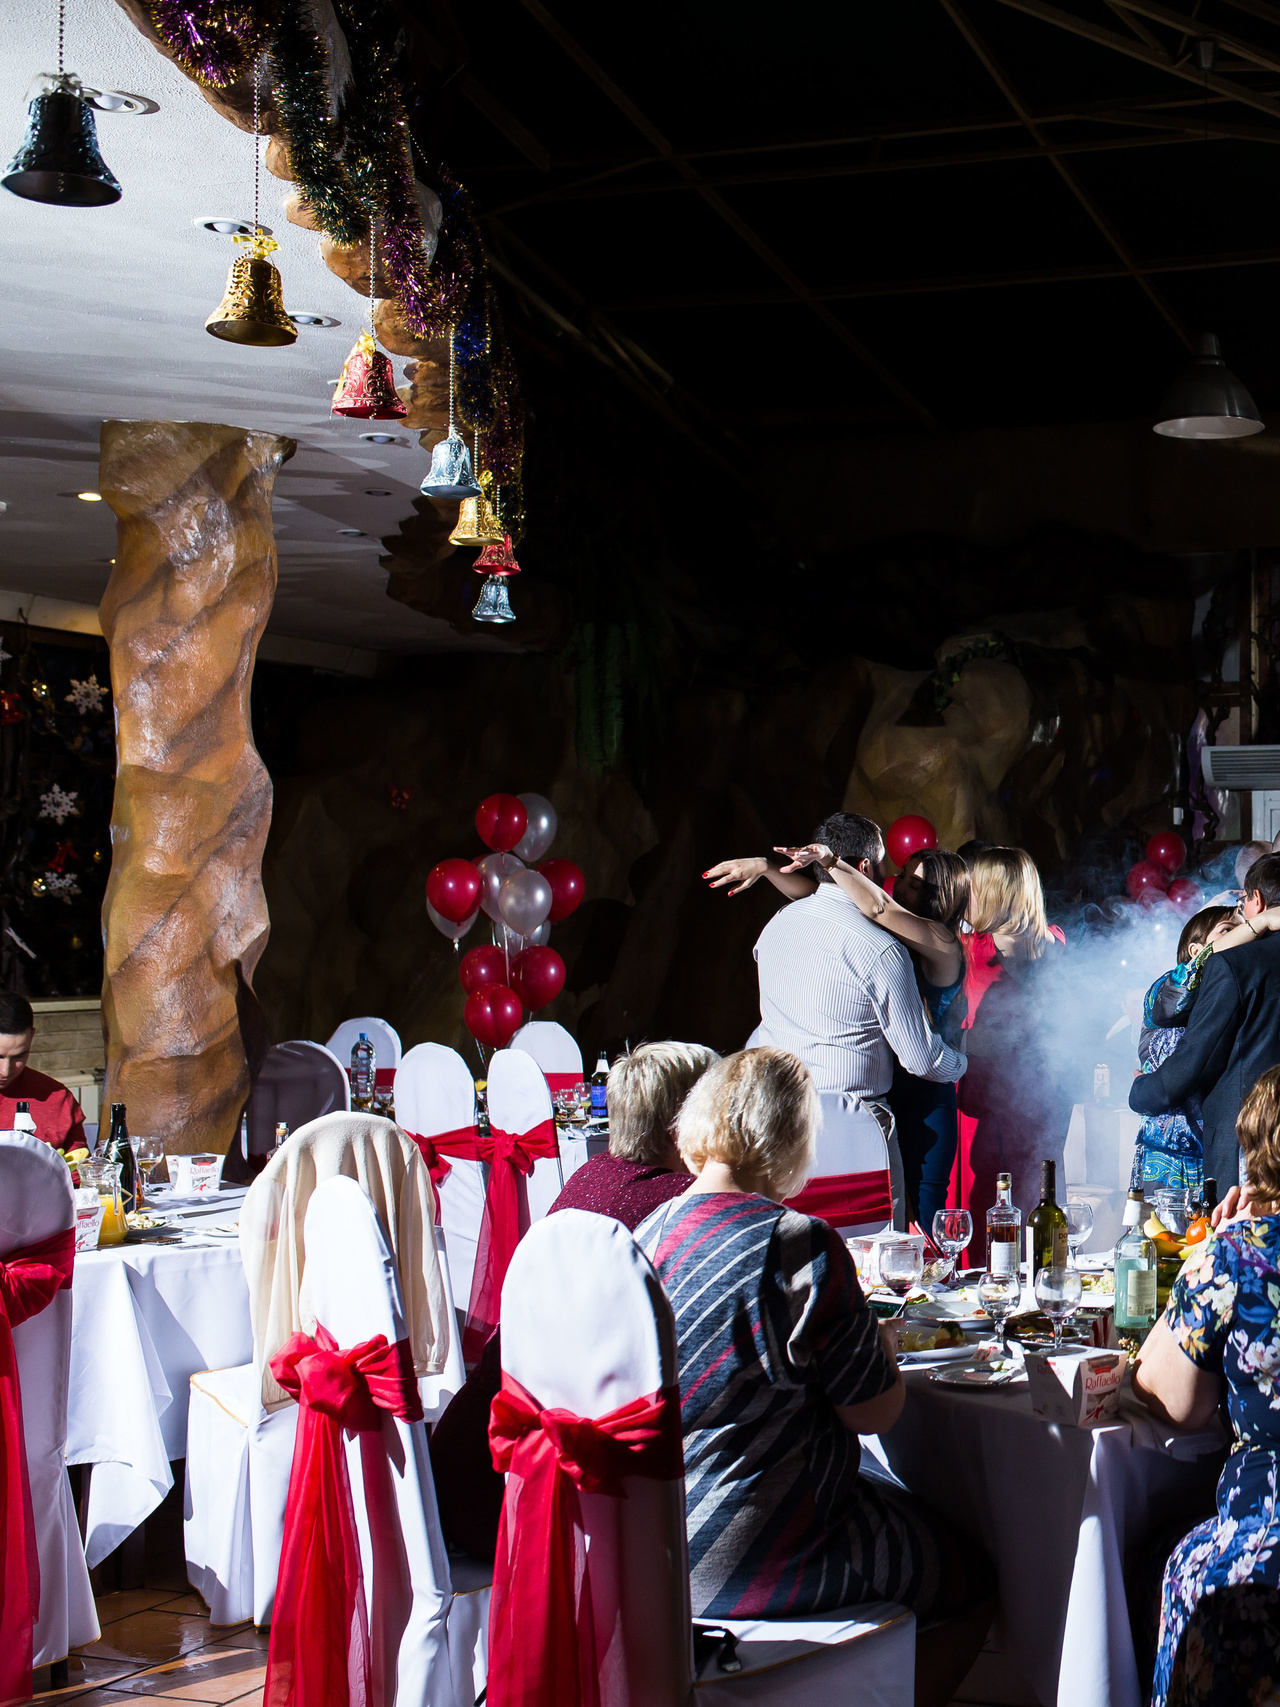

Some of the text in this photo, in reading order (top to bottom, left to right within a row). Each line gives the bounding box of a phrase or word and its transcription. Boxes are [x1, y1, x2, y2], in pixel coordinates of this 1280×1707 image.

[190, 1166, 219, 1175] Raffaello
[75, 1218, 100, 1229] affaello
[1085, 1373, 1121, 1391] Raffaello
